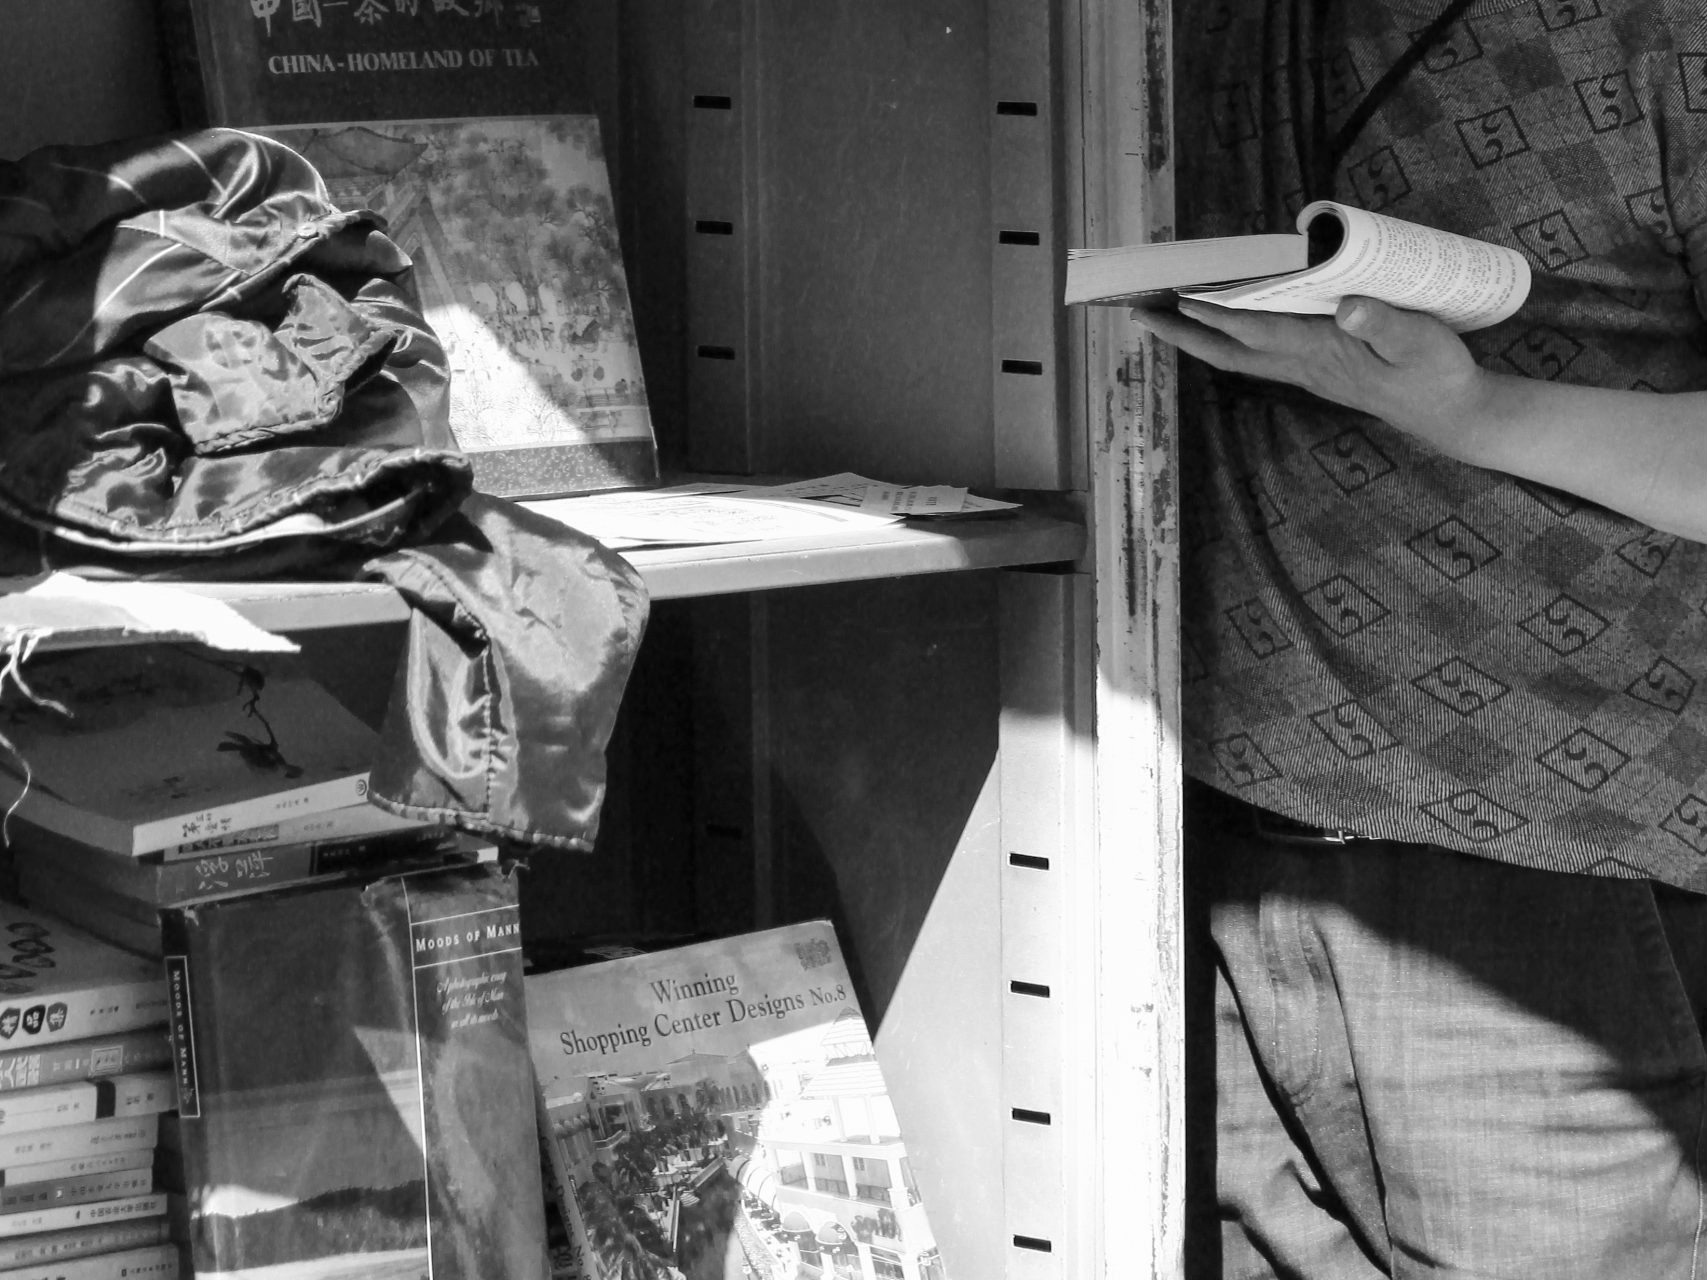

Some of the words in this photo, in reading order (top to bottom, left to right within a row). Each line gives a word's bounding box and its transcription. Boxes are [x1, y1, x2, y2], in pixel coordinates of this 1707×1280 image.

[469, 48, 496, 68] OF
[502, 47, 540, 68] TEA
[650, 972, 739, 1004] Winning
[559, 1021, 652, 1056] Shopping
[654, 1009, 722, 1038] Center
[726, 993, 806, 1023] Designs
[808, 983, 848, 1007] No.8
